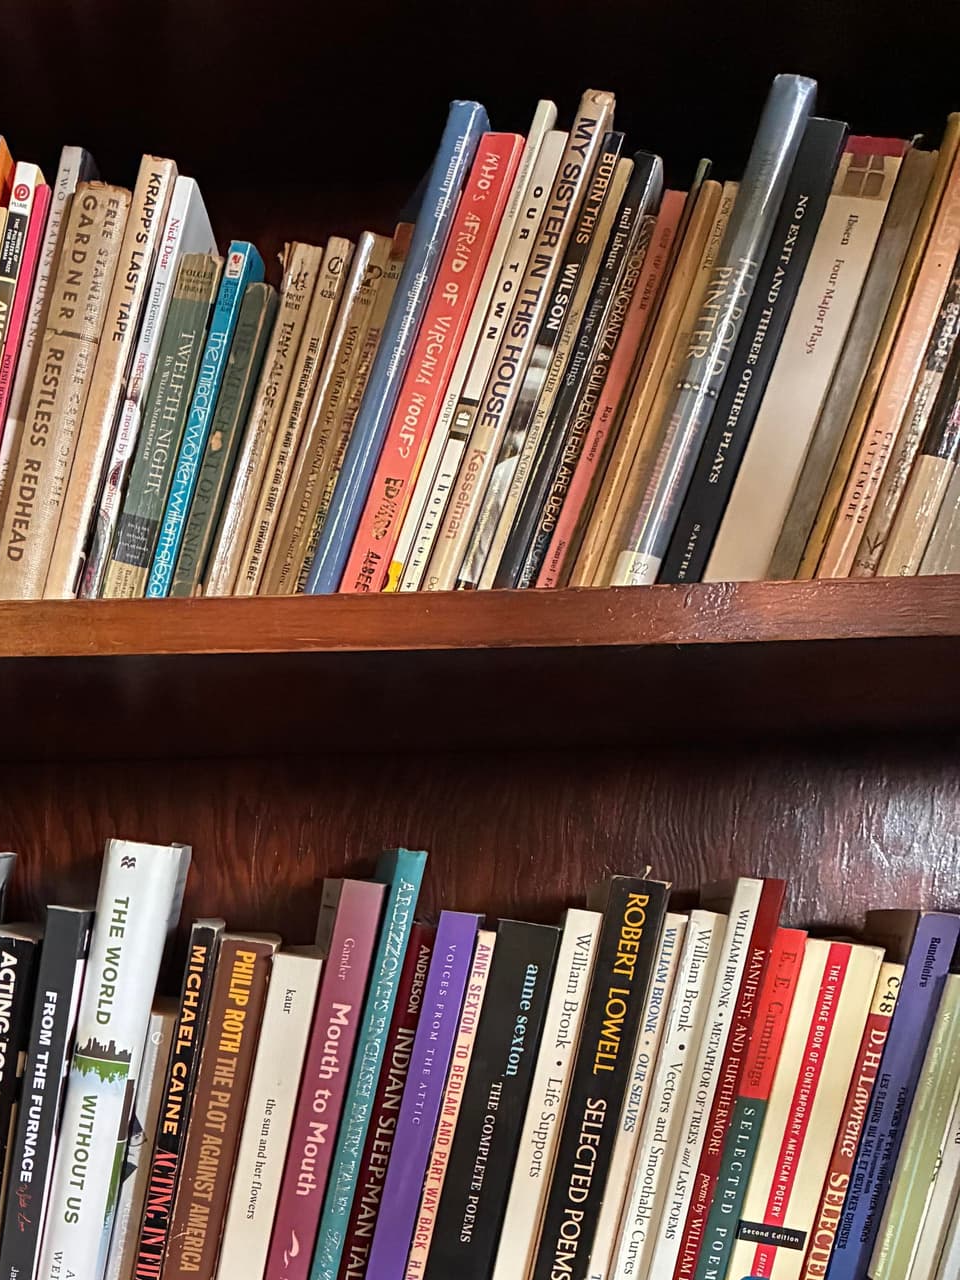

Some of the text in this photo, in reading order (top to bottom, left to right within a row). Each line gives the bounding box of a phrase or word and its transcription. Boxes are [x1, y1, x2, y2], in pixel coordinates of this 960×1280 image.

[397, 153, 500, 459] WHO'S AFRAID OF VIRGINIA WOOLF?
[480, 117, 597, 429] MY SISTER IN THIS HOUSE
[8, 195, 96, 562] GARDNER REDHEAD
[228, 950, 256, 1006] PHILIP
[613, 893, 650, 980] ROBERT
[176, 945, 207, 1054] MICHAEL
[219, 1008, 247, 1053] ROTH
[283, 989, 296, 1015] kaur
[506, 964, 539, 1076] anne sexton
[556, 932, 592, 1050] William Bronk
[593, 988, 627, 1075] LOWELL
[64, 896, 130, 1224] THE WORLD WITHOUT US
[162, 1062, 188, 1136] CAINE
[212, 1056, 237, 1094] THE
[296, 1003, 352, 1196] Mouth to Mouth
[205, 1097, 227, 1131] PLOT
[569, 1098, 607, 1203] SELECTED
[193, 1134, 222, 1201] AGAINST
[179, 1204, 210, 1272] AMERICA
[742, 1227, 800, 1243] Second Edition
